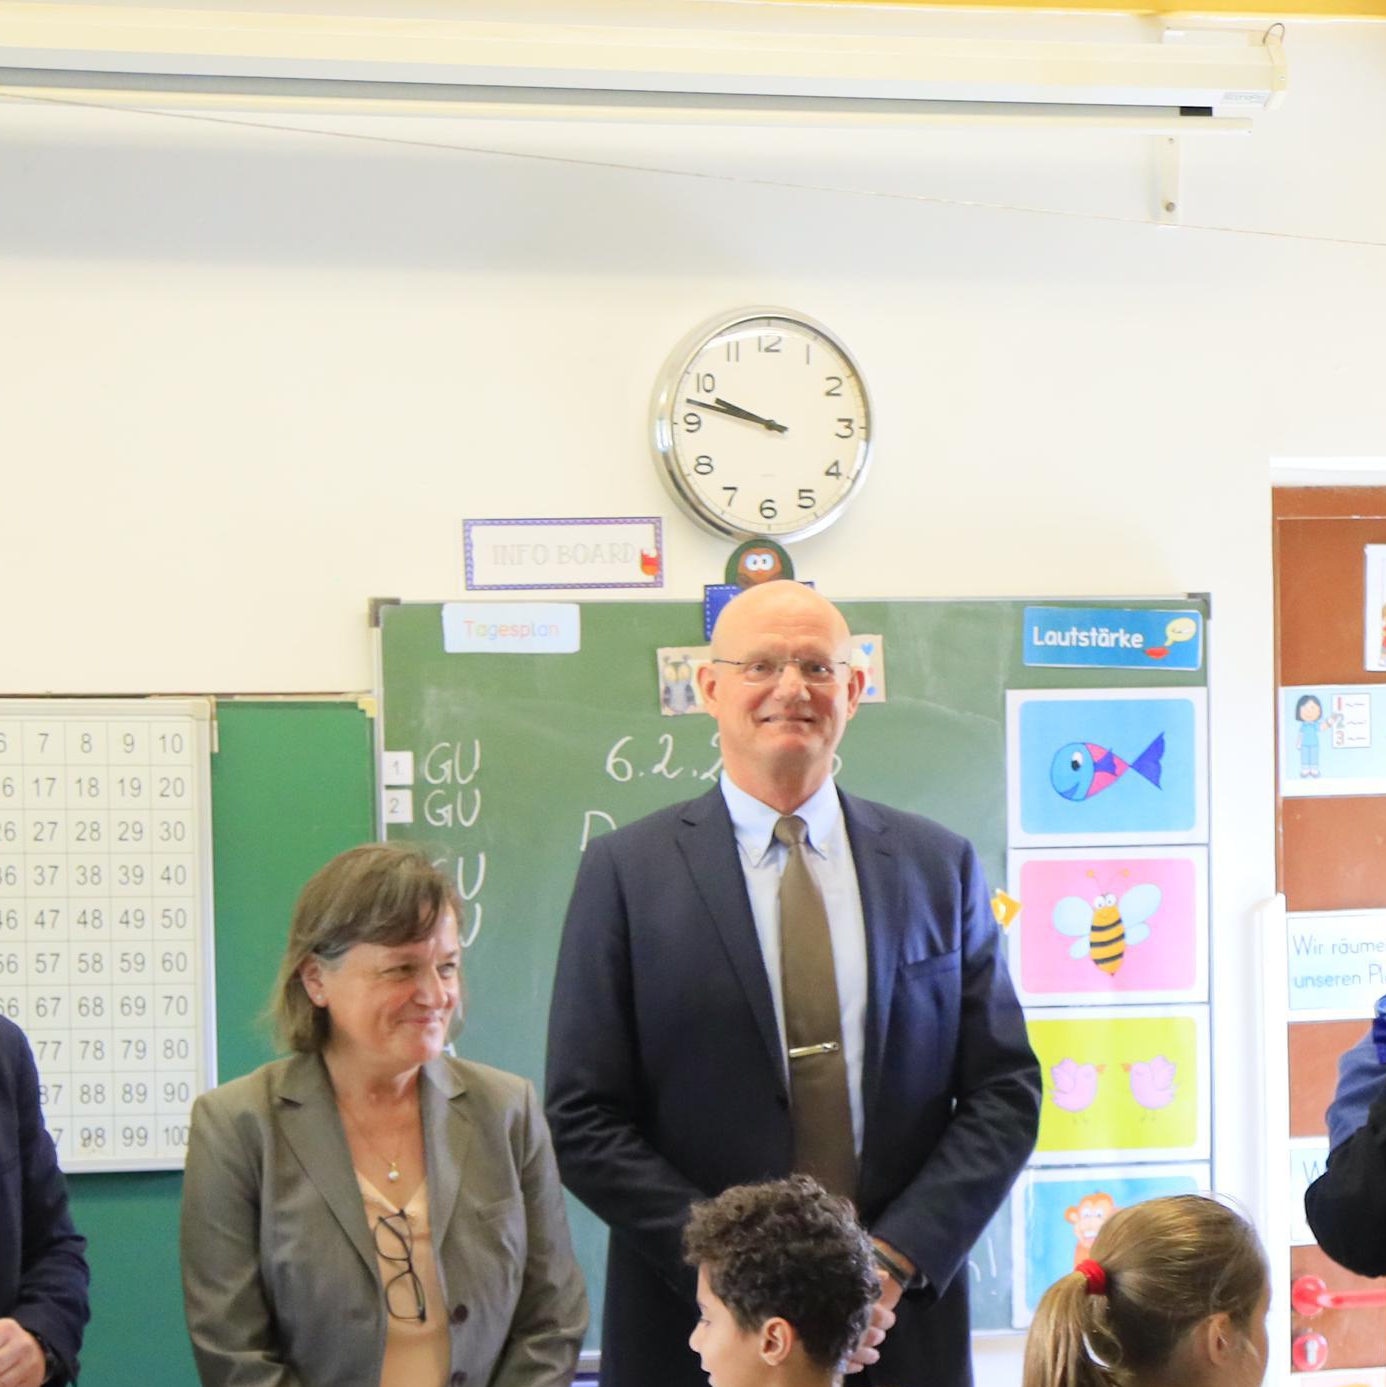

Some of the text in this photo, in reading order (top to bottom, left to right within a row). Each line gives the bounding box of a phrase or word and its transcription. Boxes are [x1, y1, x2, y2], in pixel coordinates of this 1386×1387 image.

[726, 340, 740, 363] 11
[757, 335, 782, 353] 12
[805, 343, 811, 365] 1
[696, 373, 716, 394] 10
[824, 376, 844, 397] 2
[683, 412, 702, 433] 9
[834, 417, 855, 439] 3
[693, 454, 714, 475] 8
[824, 459, 843, 480] 4
[721, 486, 739, 507] 7
[797, 488, 817, 509] 5
[759, 498, 778, 520] 6
[491, 541, 637, 567] INFO BOARD
[463, 619, 560, 641] Tagesplan
[1032, 625, 1145, 649] Lautstärke
[37, 732, 50, 753] 7
[80, 732, 93, 754] 8
[123, 732, 135, 754] 9
[158, 732, 183, 754] 10
[424, 738, 482, 786] GU
[32, 776, 57, 797] 17
[75, 776, 100, 798] 18
[118, 776, 142, 798] 19
[159, 776, 185, 798] 20
[423, 788, 482, 829] GU
[32, 820, 59, 842] 27
[75, 820, 101, 842] 28
[117, 820, 144, 842] 29
[159, 820, 186, 842] 30
[33, 864, 60, 887] 37
[76, 864, 102, 886] 38
[118, 864, 145, 886] 39
[159, 864, 187, 886] 40
[33, 908, 61, 929] 47
[76, 908, 103, 930] 48
[118, 908, 145, 930] 49
[161, 907, 187, 929] 50
[1292, 933, 1325, 956] Wir
[35, 952, 61, 974] 57
[77, 952, 104, 974] 58
[119, 952, 146, 973] 59
[161, 951, 188, 973] 60
[1293, 973, 1363, 989] unseren
[34, 996, 62, 1018] 67
[77, 995, 105, 1018] 68
[119, 995, 147, 1017] 69
[162, 994, 188, 1016] 70
[36, 1038, 189, 1062] 77 78 79 80
[79, 1083, 106, 1105] 88
[121, 1082, 148, 1104] 89
[163, 1081, 191, 1104] 90
[80, 1126, 106, 1149] 98
[121, 1125, 149, 1148] 99
